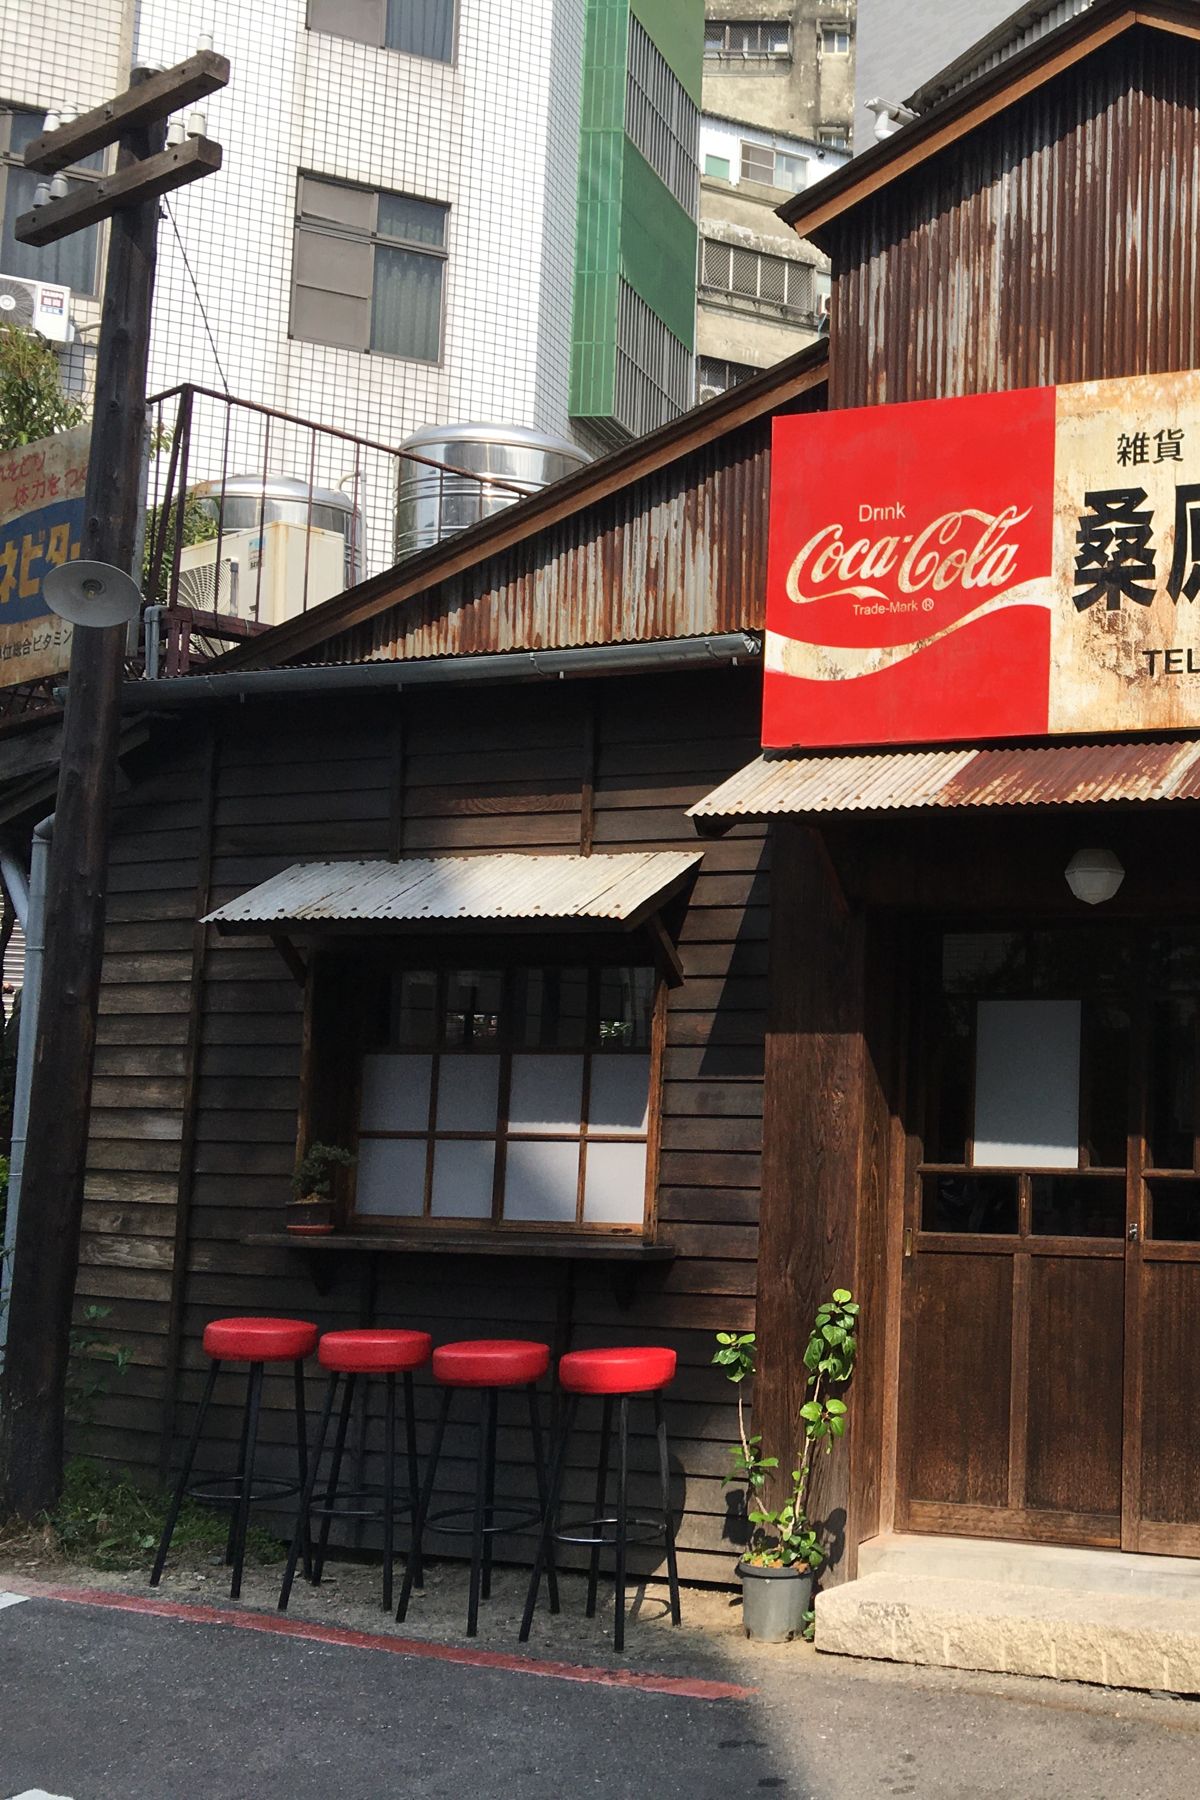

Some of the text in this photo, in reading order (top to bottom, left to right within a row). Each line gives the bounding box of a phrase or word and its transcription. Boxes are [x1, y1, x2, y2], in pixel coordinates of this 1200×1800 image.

[1115, 427, 1184, 468] 雑貨
[858, 501, 906, 523] Drink
[785, 504, 1034, 605] Coca-Cola
